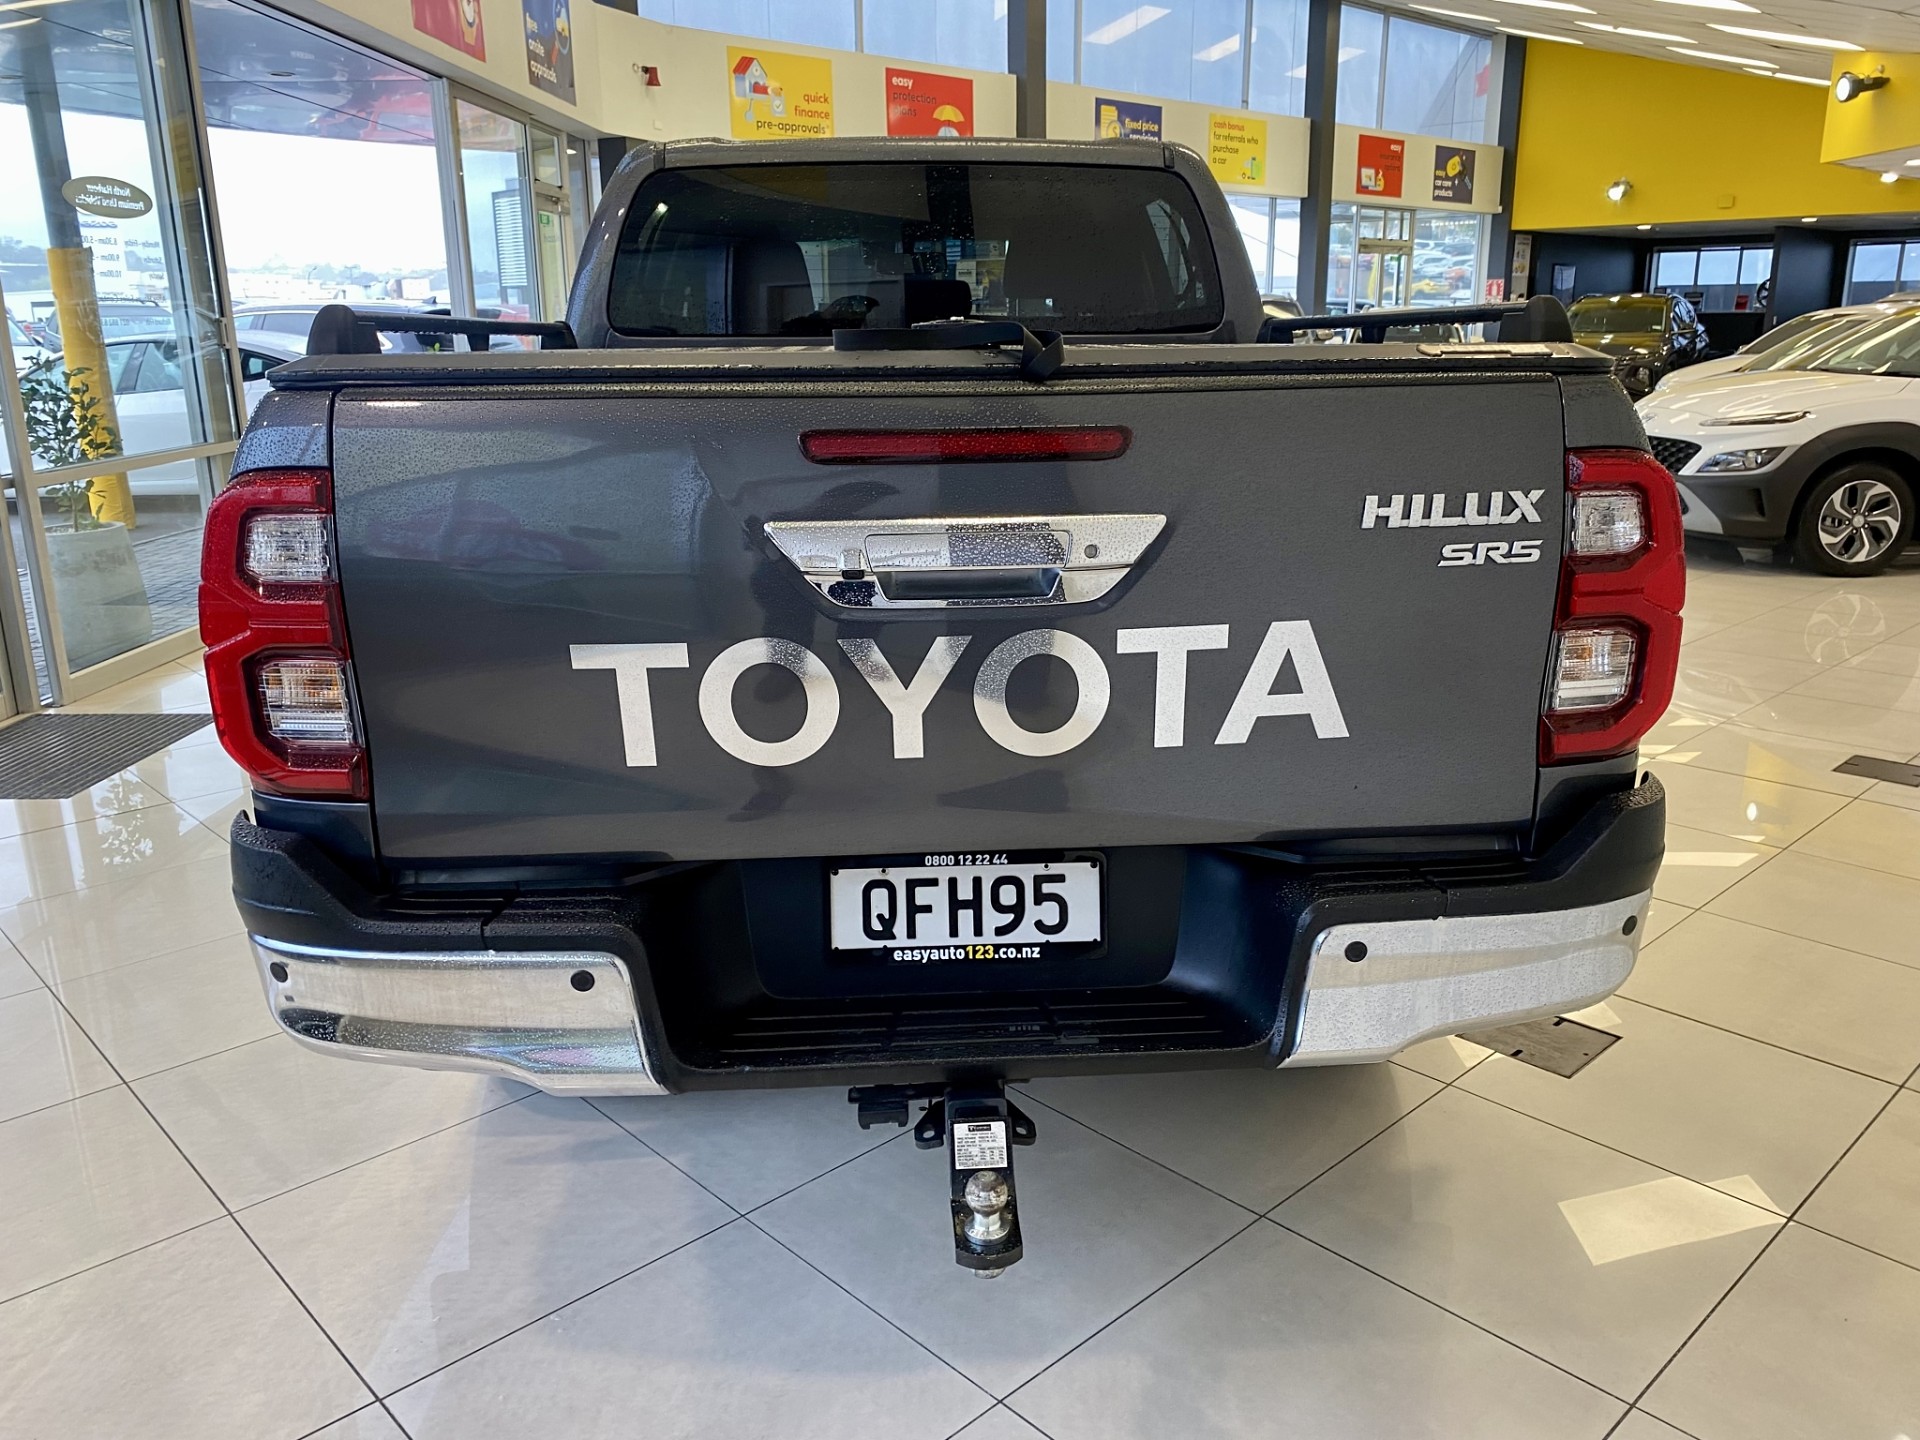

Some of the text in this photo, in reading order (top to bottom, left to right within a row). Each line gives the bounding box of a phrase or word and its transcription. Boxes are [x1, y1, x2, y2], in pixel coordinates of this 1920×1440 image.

[530, 60, 557, 84] appraisals
[891, 76, 914, 90] easy
[803, 92, 830, 105] quick
[892, 91, 937, 105] protection
[794, 105, 830, 120] finance
[1142, 120, 1159, 132] price
[1213, 121, 1245, 132] cash bonus
[1213, 131, 1259, 145] for referrals who
[1212, 145, 1239, 154] purchase
[1434, 189, 1453, 198] products
[1361, 489, 1546, 529] HILUX
[1437, 539, 1544, 567] SR5
[569, 619, 1350, 768] TOYOTA
[924, 854, 1008, 867] 0800 12 22 44
[862, 873, 1069, 941] QFH95
[893, 945, 1041, 963] easyauto123.co.nz
